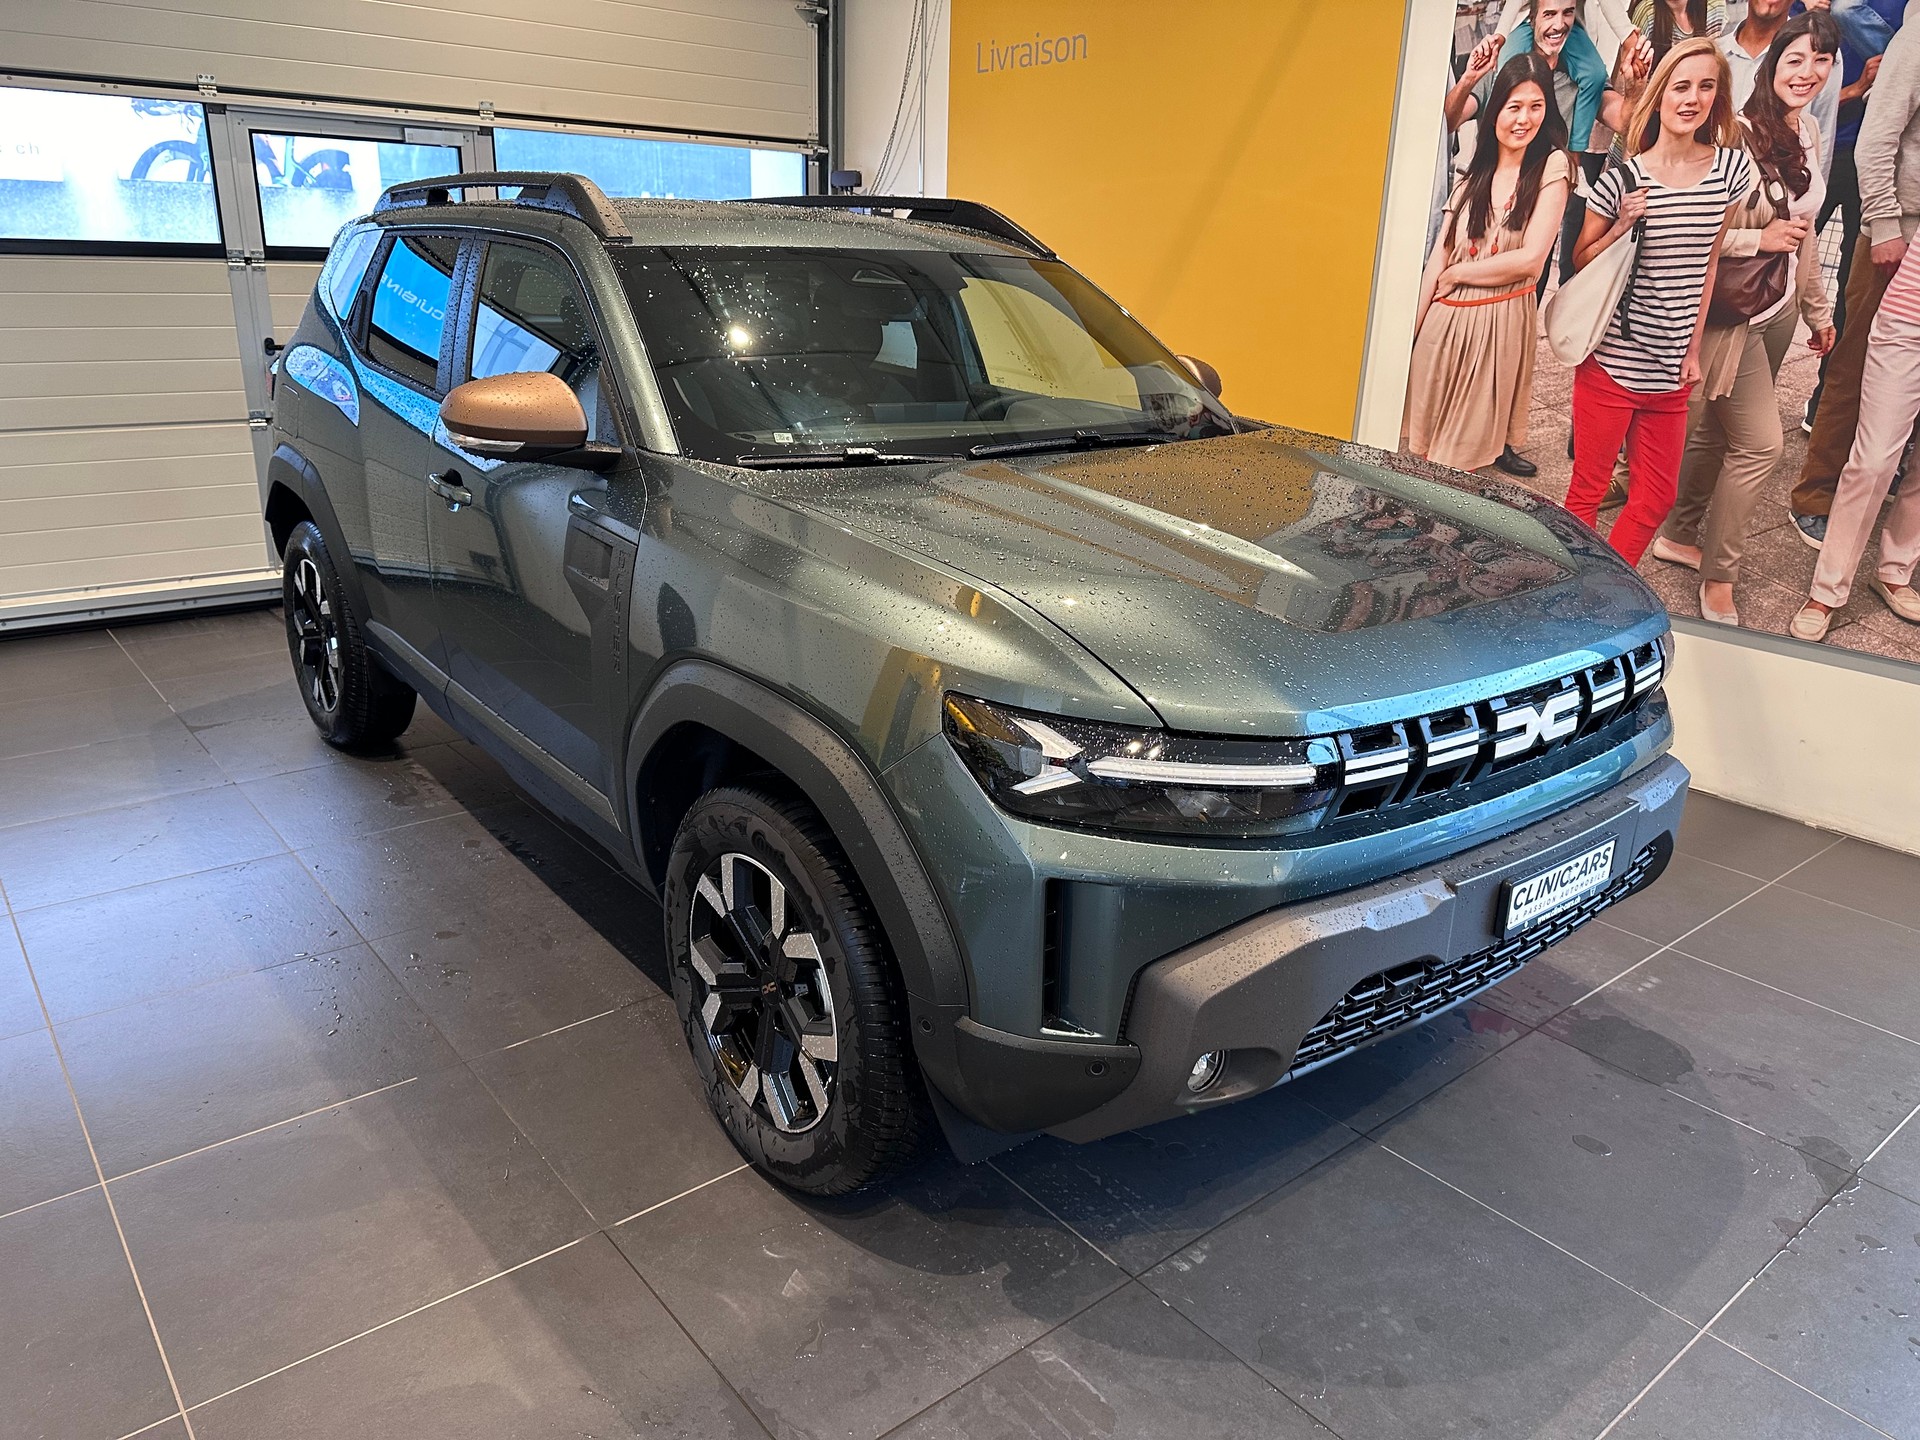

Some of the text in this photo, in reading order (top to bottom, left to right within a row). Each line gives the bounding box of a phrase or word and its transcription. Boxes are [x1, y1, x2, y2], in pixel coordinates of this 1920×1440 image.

[976, 32, 1088, 74] Livraison
[1523, 896, 1556, 918] PASSION
[1559, 870, 1606, 899] AUTOMOBILE
